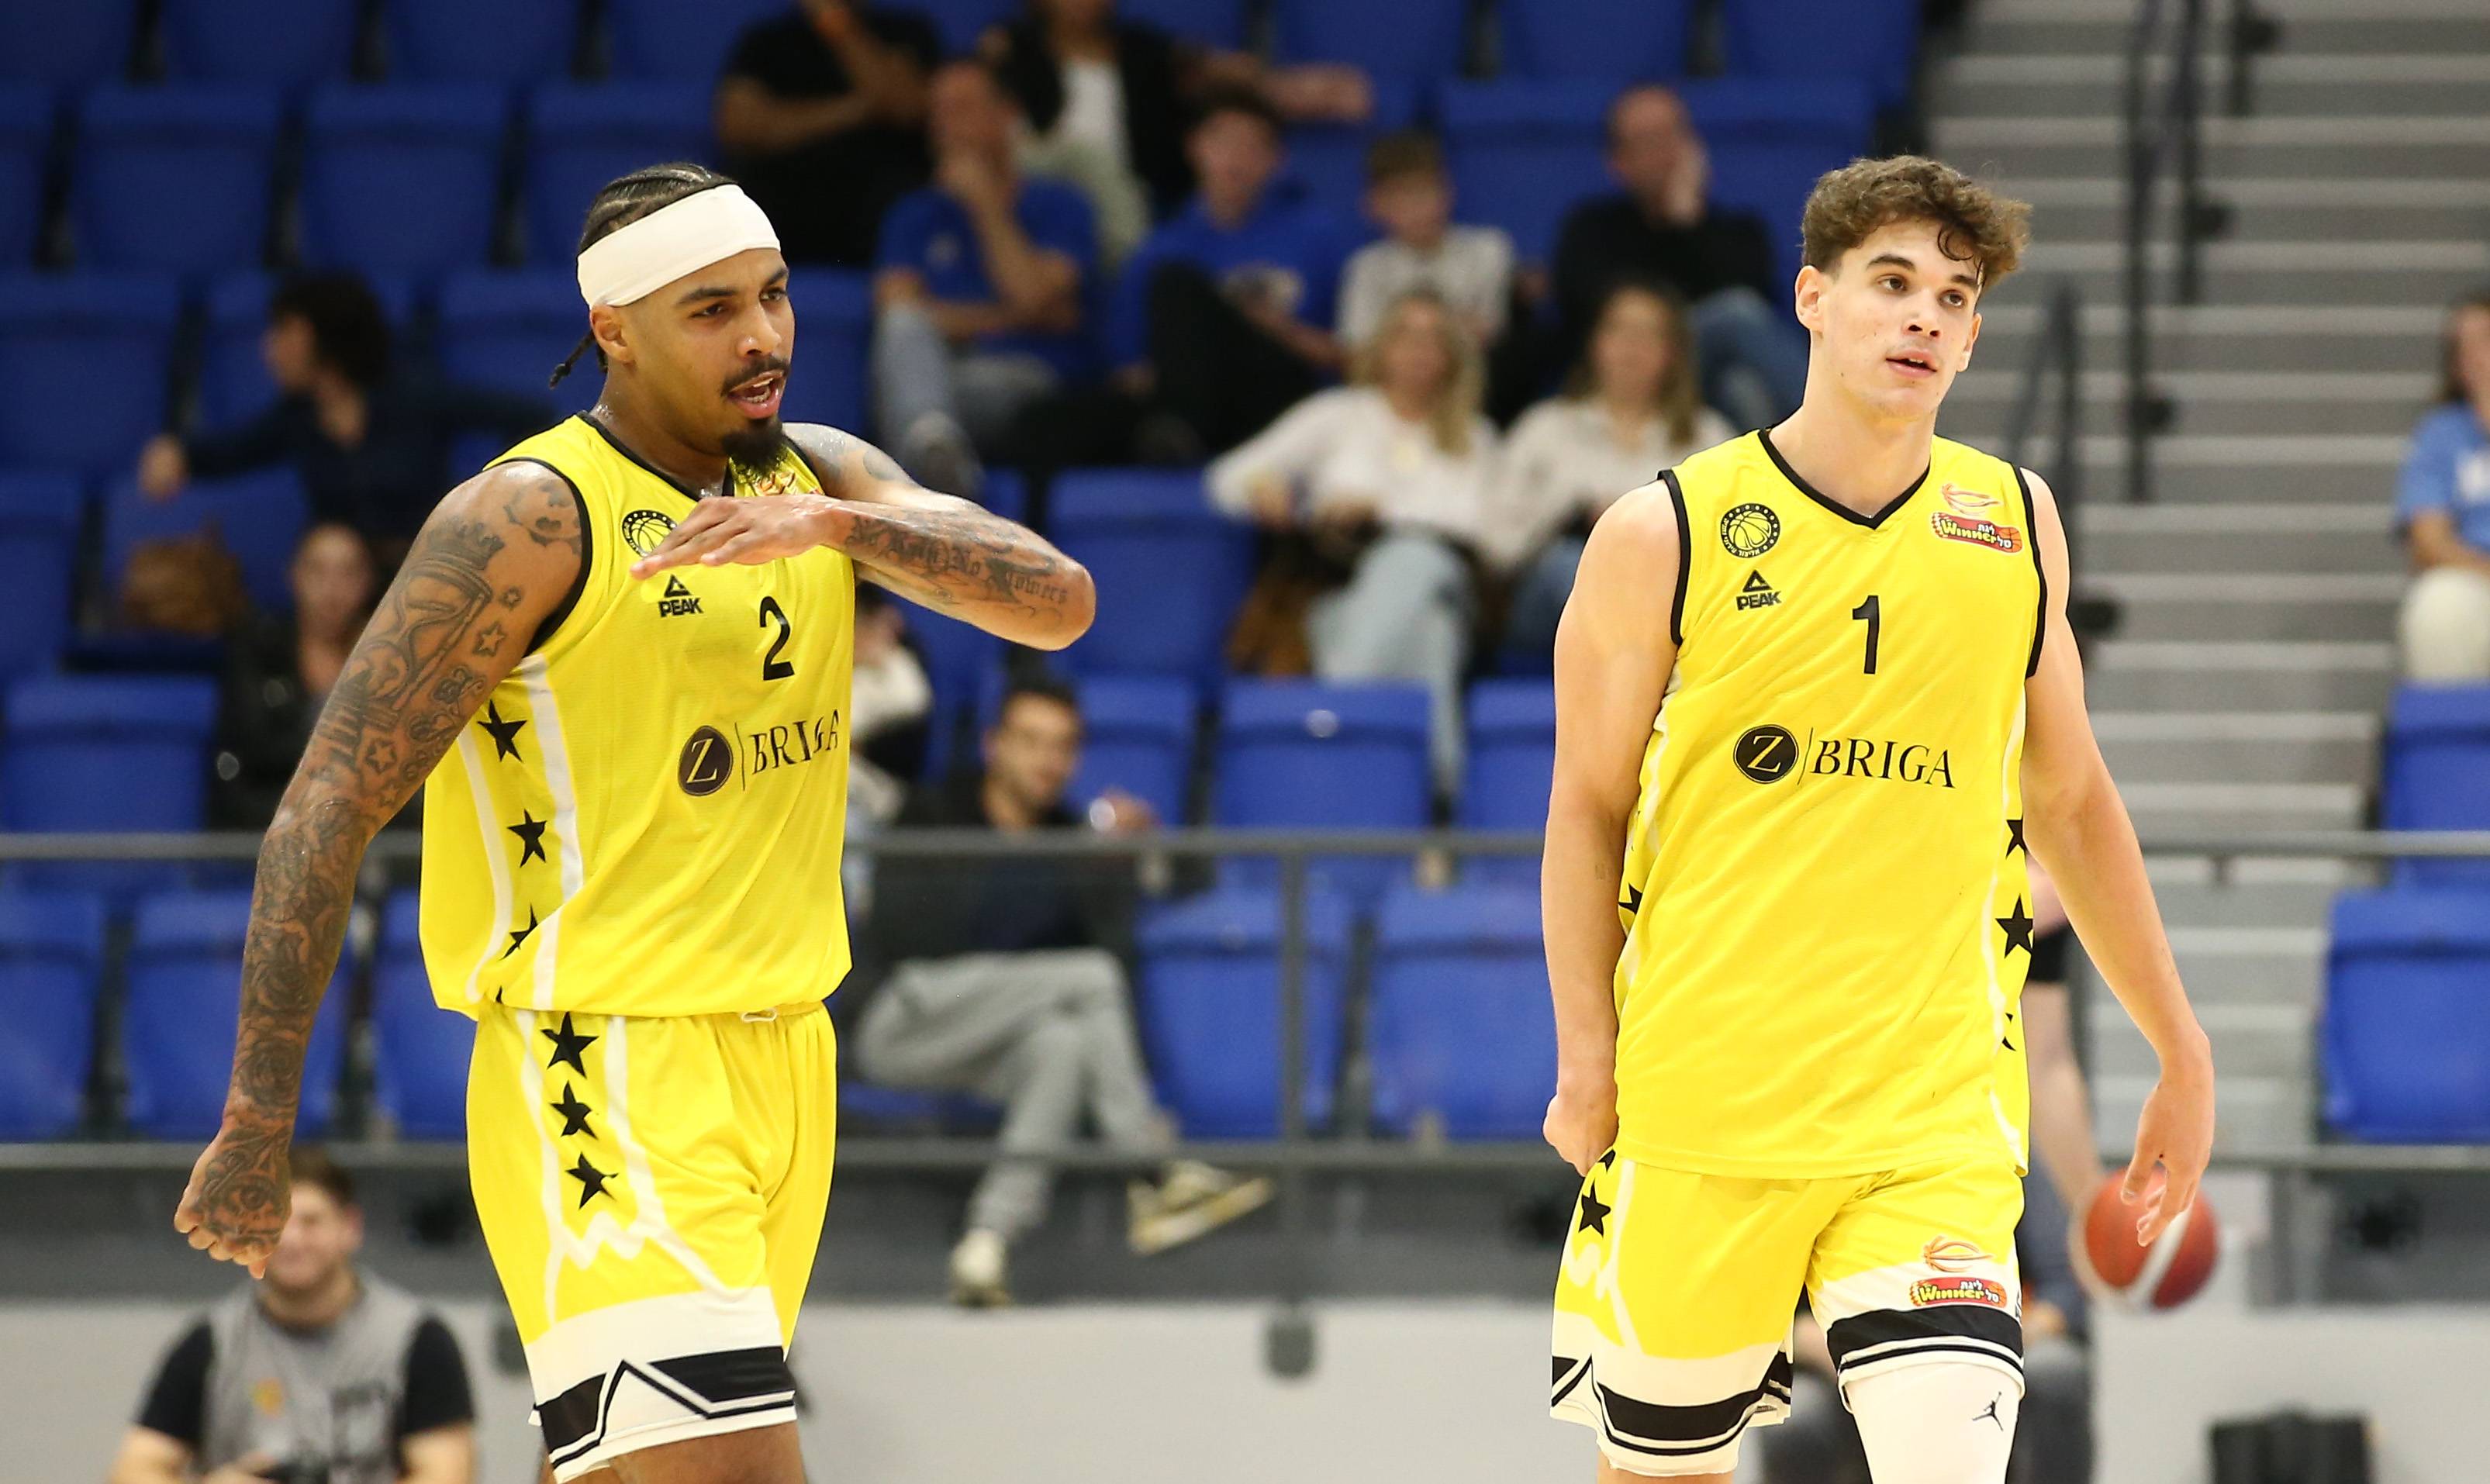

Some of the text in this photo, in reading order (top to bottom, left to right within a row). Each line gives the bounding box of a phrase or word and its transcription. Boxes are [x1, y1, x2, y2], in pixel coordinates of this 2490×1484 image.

[1940, 519, 1997, 544] Winner
[658, 597, 704, 618] PEAK
[1735, 590, 1781, 611] PEAK
[759, 595, 795, 682] 2
[1852, 595, 1880, 675] 1
[686, 737, 718, 784] Z
[1747, 735, 1956, 789] Z BRIGA
[1918, 1285, 1984, 1303] Winner
